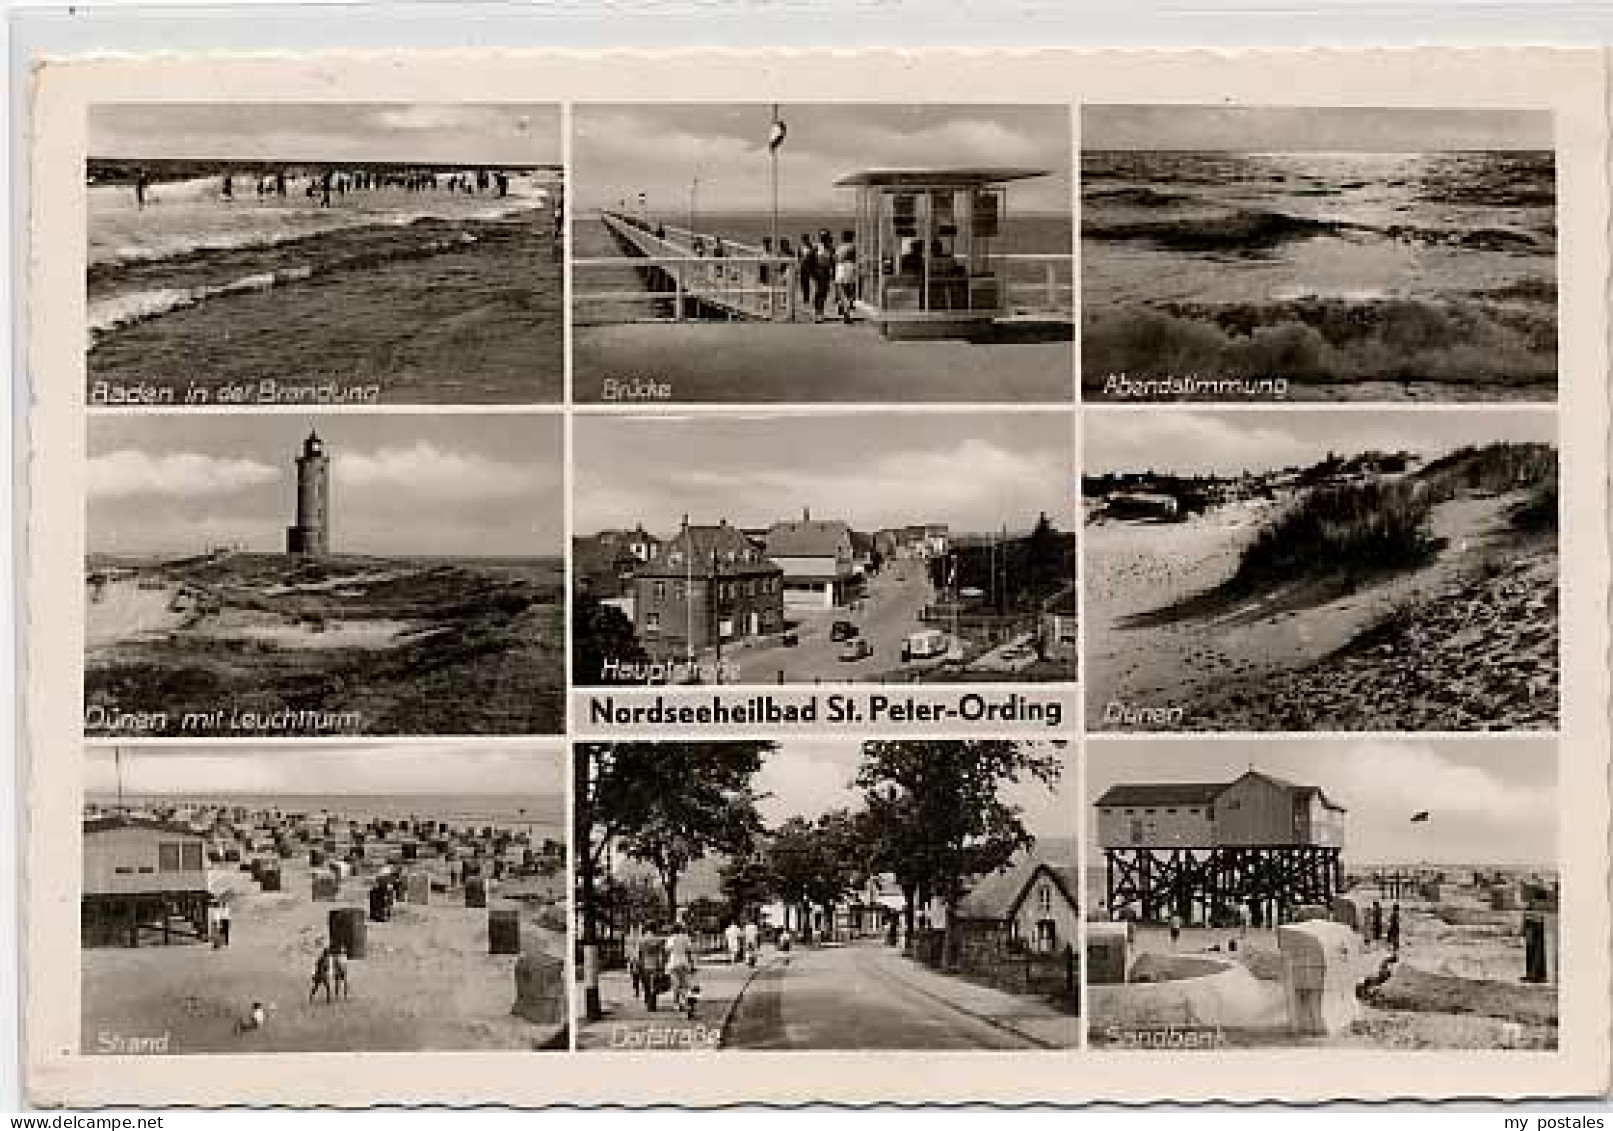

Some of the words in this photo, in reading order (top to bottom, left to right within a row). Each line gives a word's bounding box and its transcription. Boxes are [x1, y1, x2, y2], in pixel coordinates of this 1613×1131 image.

[184, 380, 207, 402] in
[216, 381, 257, 402] der
[602, 378, 672, 399] Brücke
[1103, 372, 1289, 399] Abendstimmung
[181, 709, 225, 730] mit
[589, 696, 817, 724] Nordseeheilbad
[826, 694, 863, 722] St.
[869, 693, 1062, 726] Peter-Ording
[97, 1030, 171, 1053] Strand
